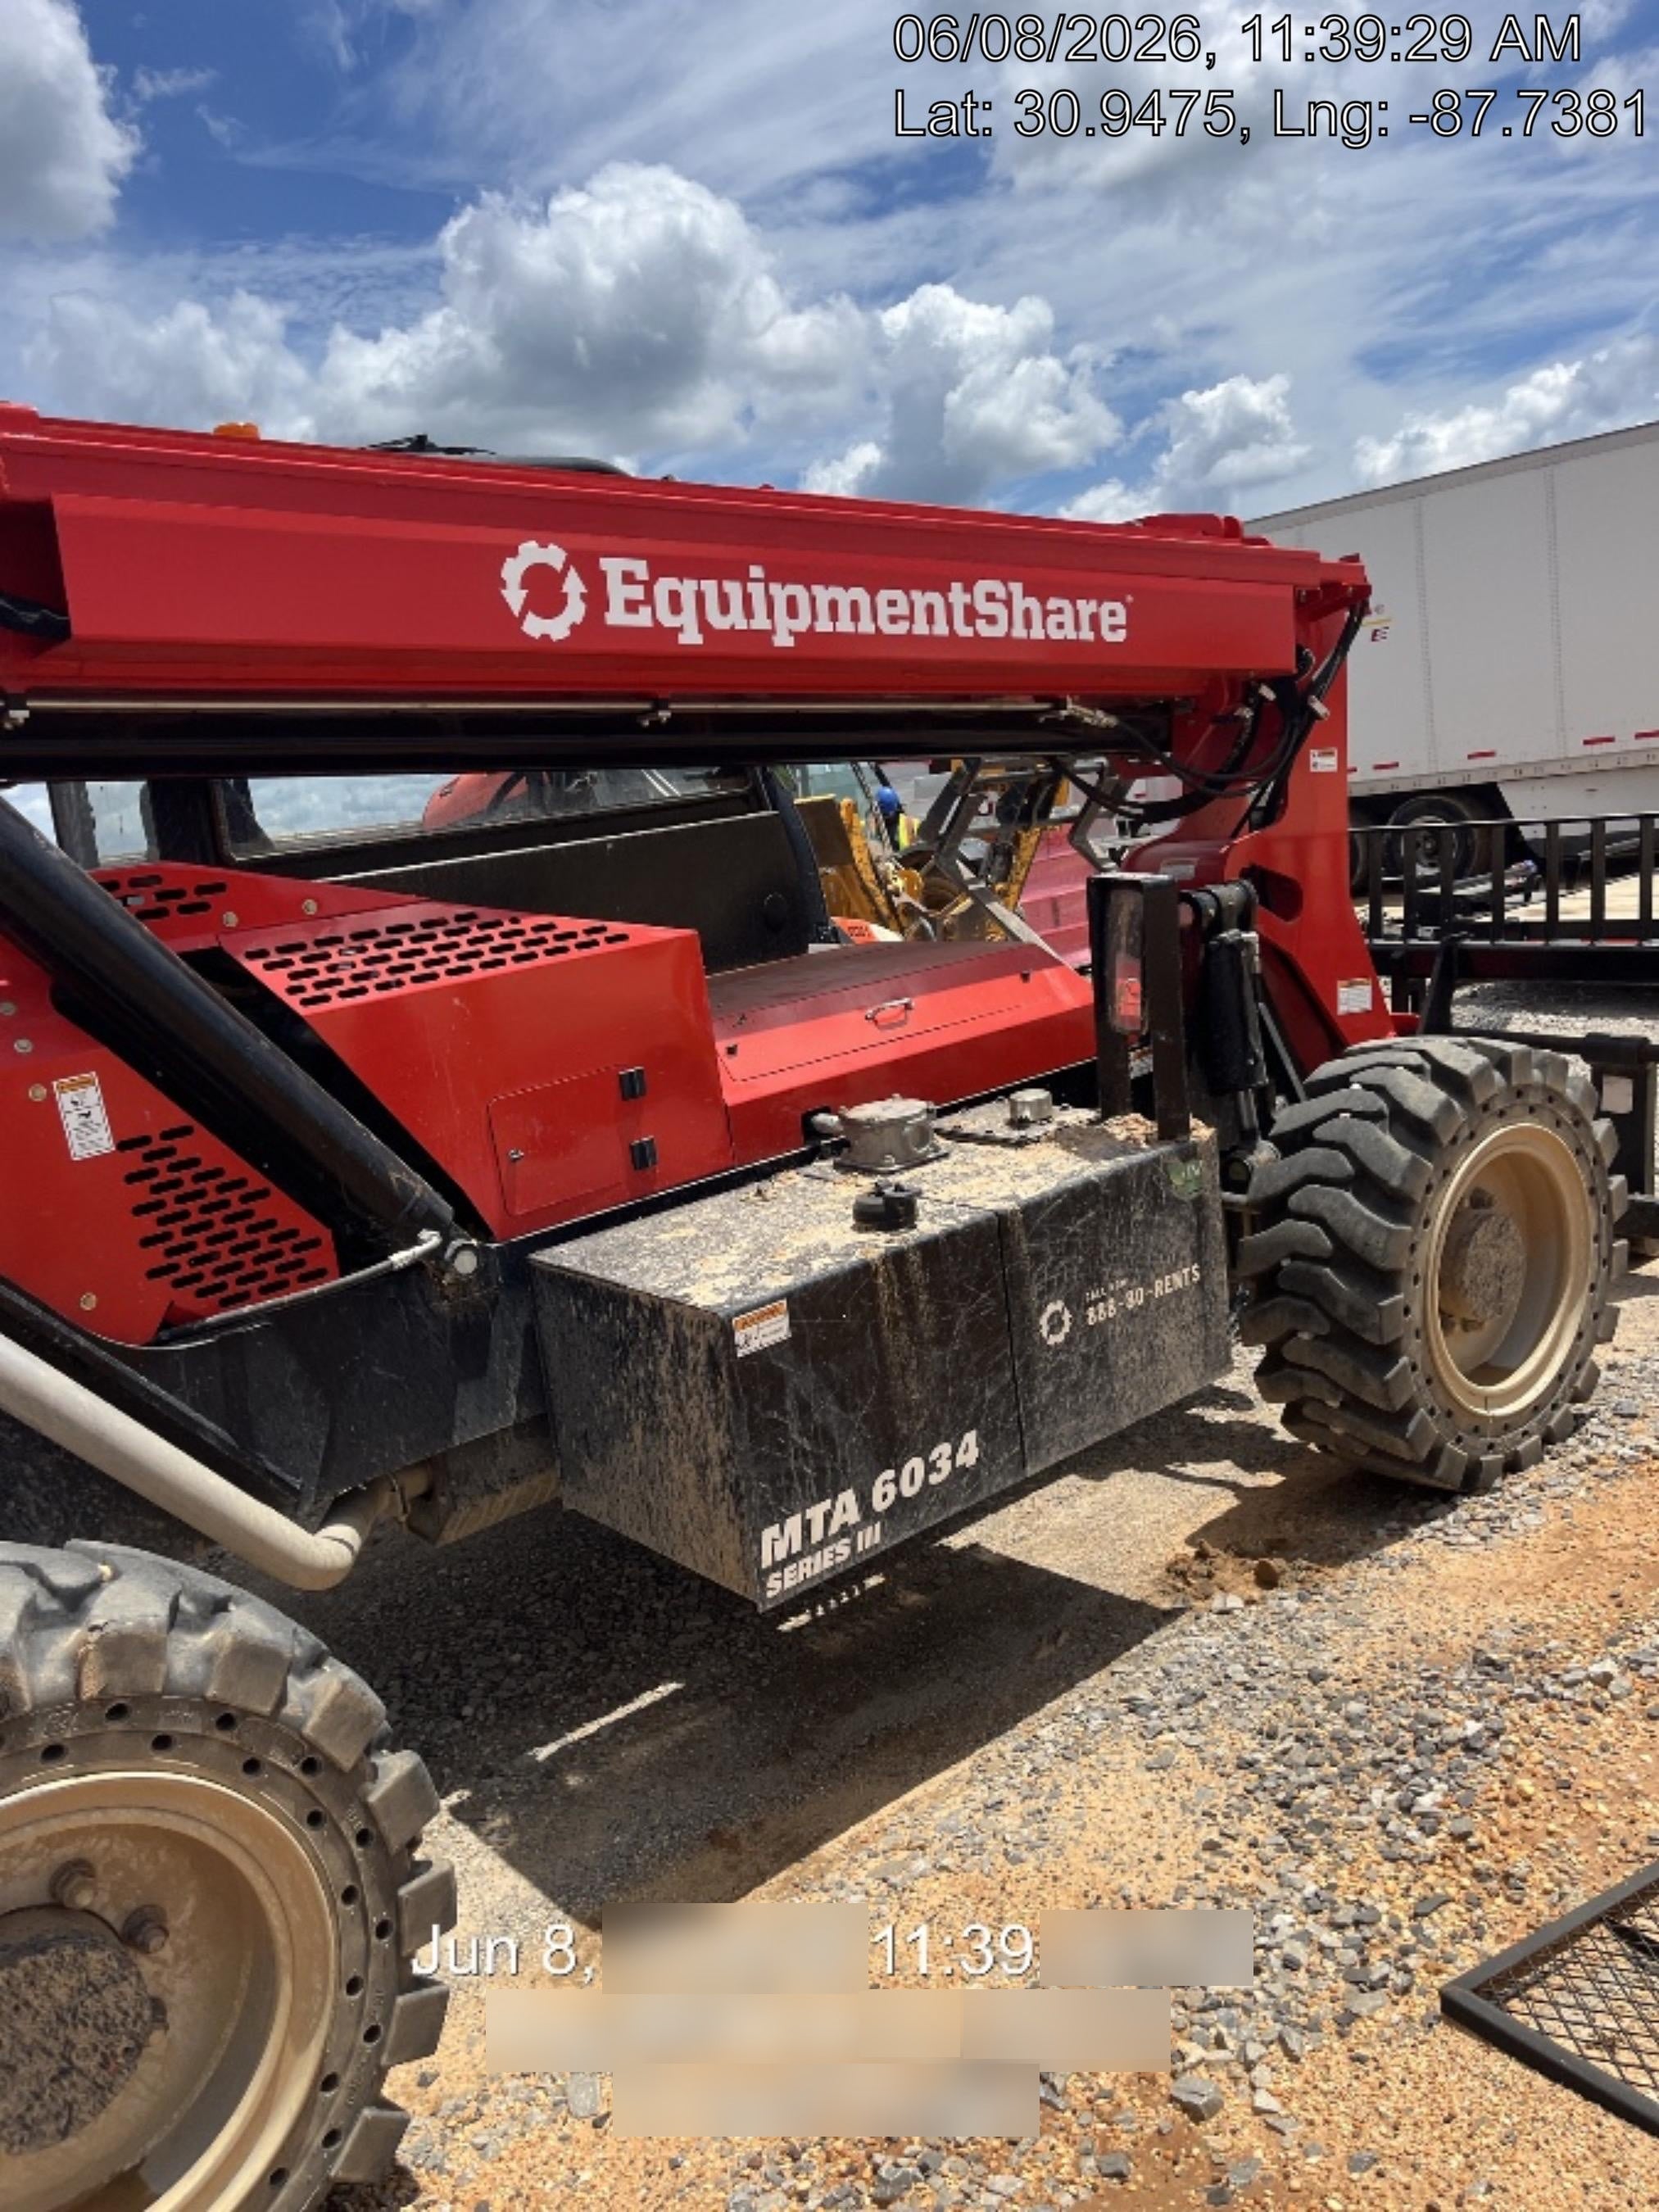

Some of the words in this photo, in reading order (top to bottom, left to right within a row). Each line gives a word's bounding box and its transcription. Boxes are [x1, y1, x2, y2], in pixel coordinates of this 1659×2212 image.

[599, 557, 1127, 647] EquipmentShare
[760, 1485, 861, 1570] MTA
[871, 1429, 980, 1512] 6034
[766, 1538, 851, 1598] SERIES
[856, 1521, 882, 1554] III
